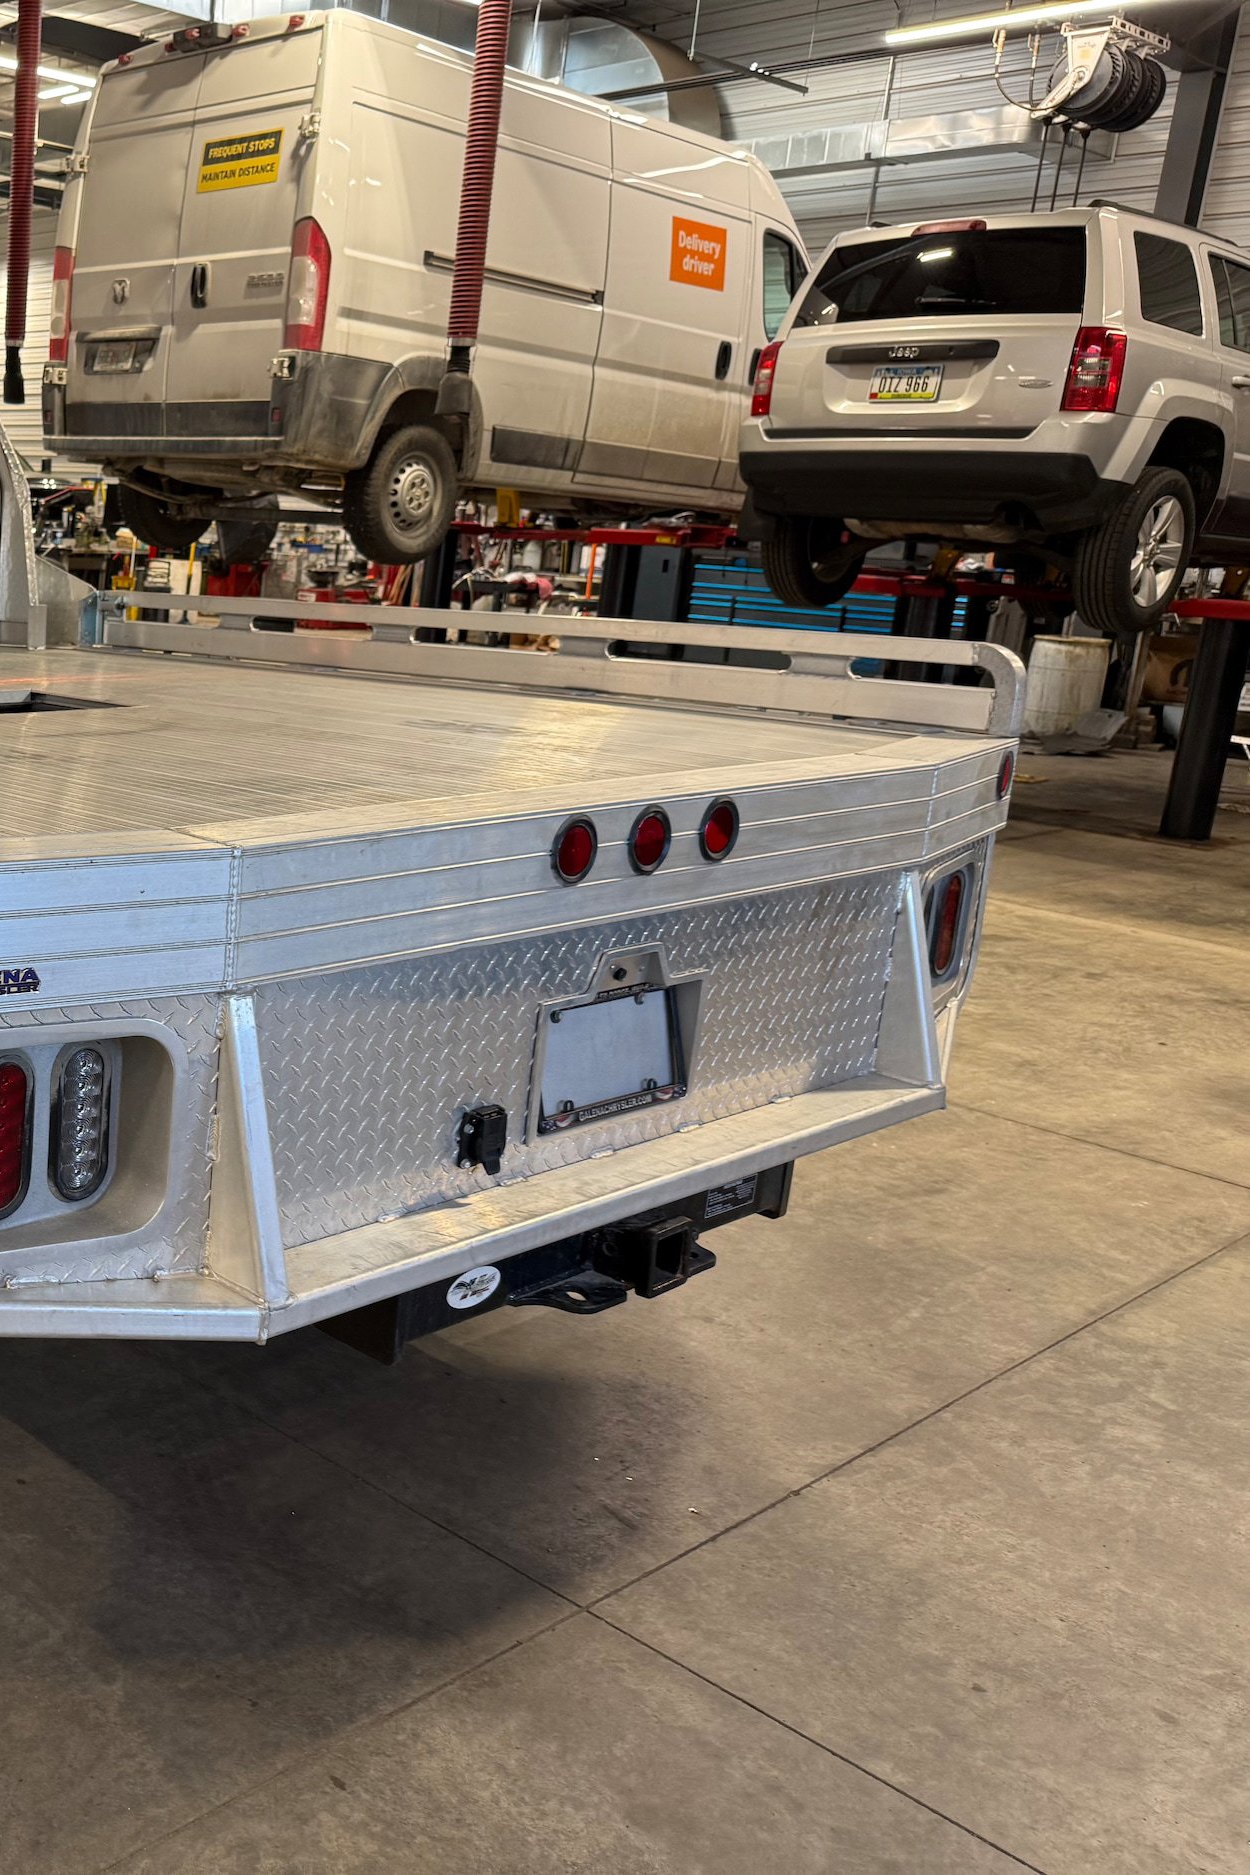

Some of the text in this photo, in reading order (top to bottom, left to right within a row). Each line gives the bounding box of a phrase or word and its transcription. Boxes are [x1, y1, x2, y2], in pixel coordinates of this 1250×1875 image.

[208, 138, 276, 159] FREQUENT STOPS
[201, 162, 276, 183] MAINTAIN DISTANCE
[678, 230, 721, 259] Delivery
[682, 254, 715, 276] driver
[889, 345, 920, 359] Jeep
[905, 375, 930, 393] 966
[578, 1093, 653, 1122] GALENACHRYSLER.COM
